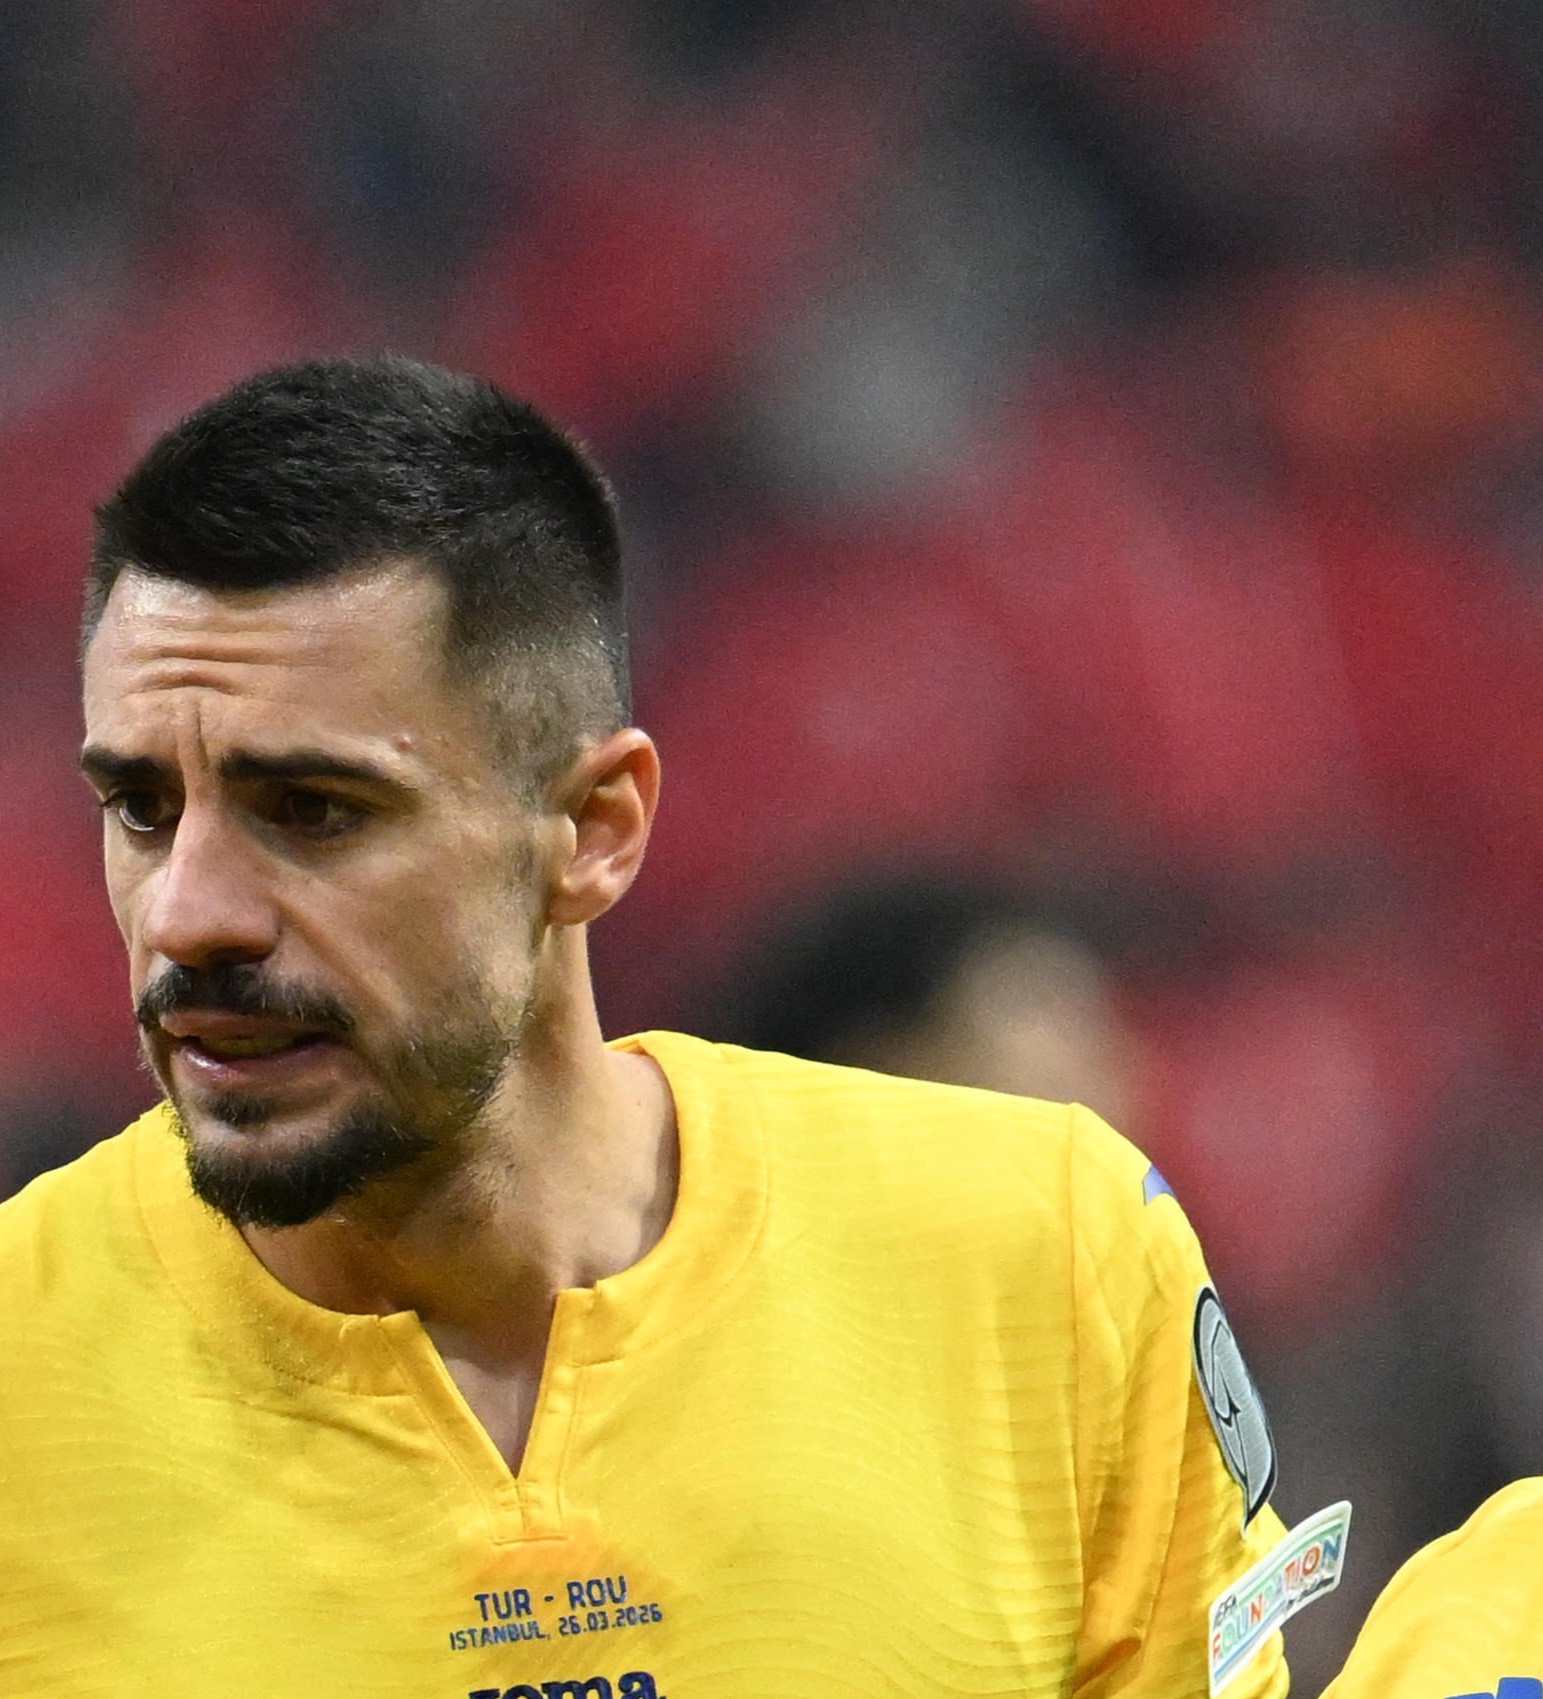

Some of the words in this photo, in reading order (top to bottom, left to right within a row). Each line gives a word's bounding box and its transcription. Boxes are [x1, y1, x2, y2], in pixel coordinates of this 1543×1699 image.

[473, 1588, 533, 1622] TUR
[566, 1575, 628, 1611] ROU
[449, 1620, 552, 1651] ISTANBUL,
[558, 1602, 663, 1638] 26.03.2026
